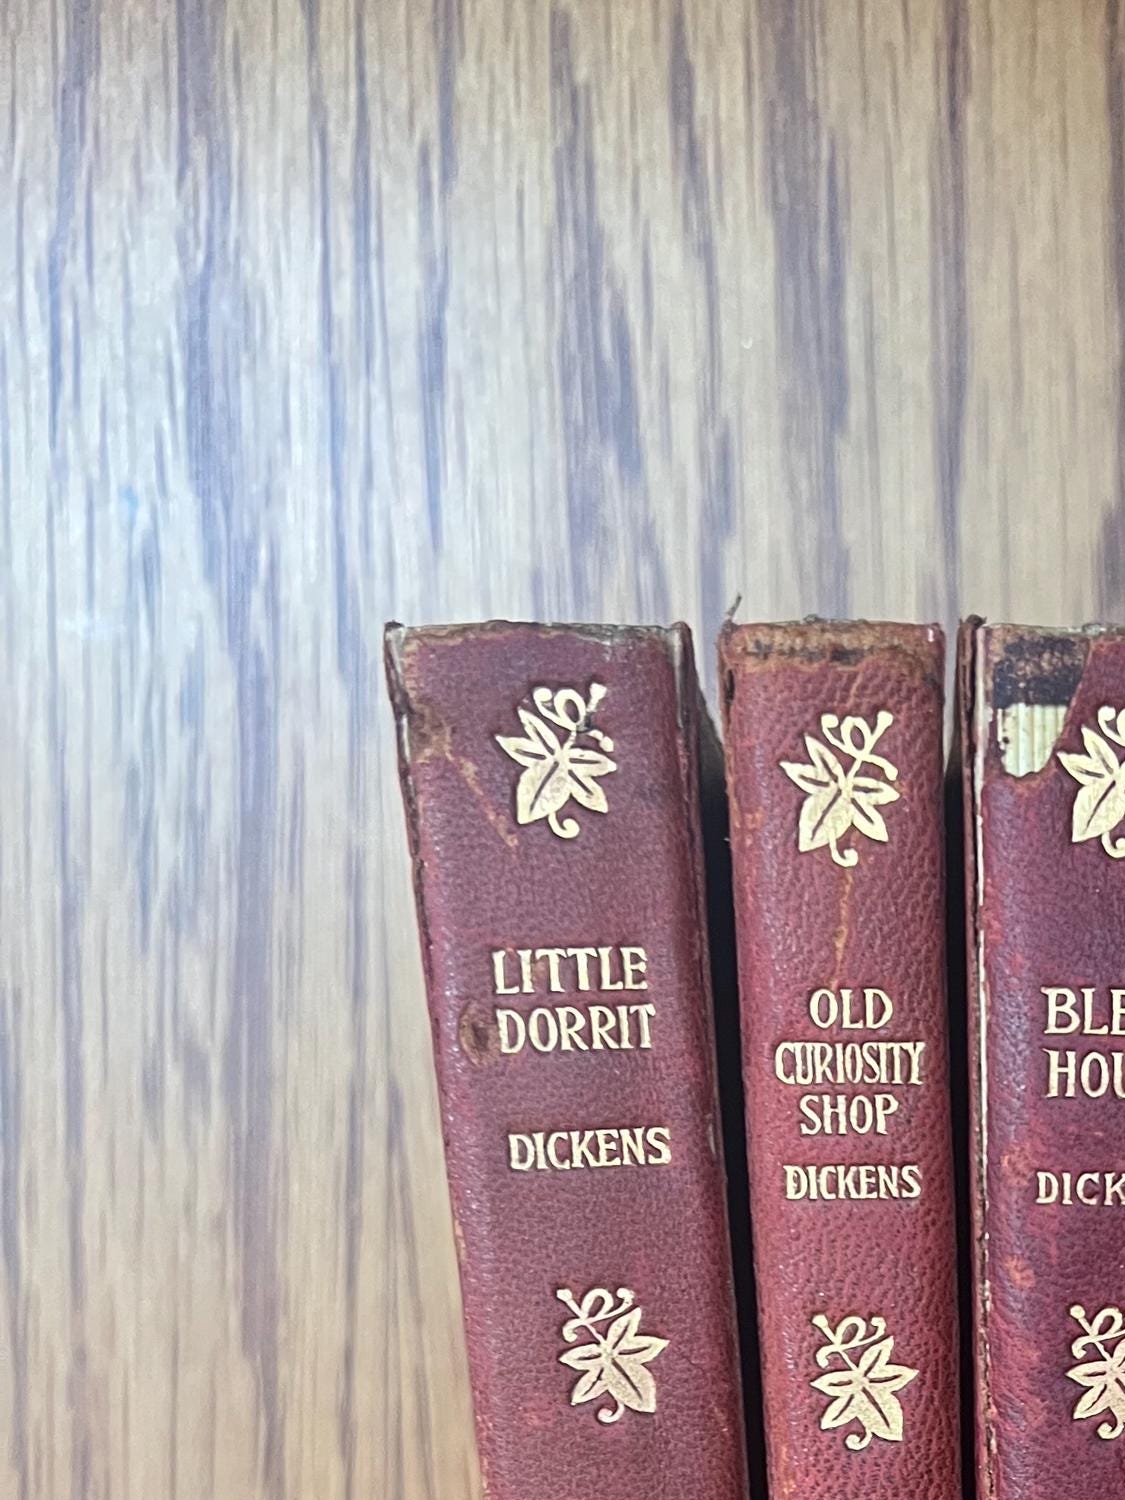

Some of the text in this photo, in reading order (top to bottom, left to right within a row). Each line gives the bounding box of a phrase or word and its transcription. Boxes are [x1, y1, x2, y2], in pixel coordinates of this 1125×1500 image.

[491, 946, 648, 995] LITTLE
[495, 1003, 656, 1054] DORRIT
[809, 987, 893, 1030] OLD
[775, 1041, 925, 1086] CURIOSITY
[800, 1094, 899, 1136] SHOP
[508, 1127, 672, 1172] DICKENS
[785, 1165, 923, 1201] DICKENS
